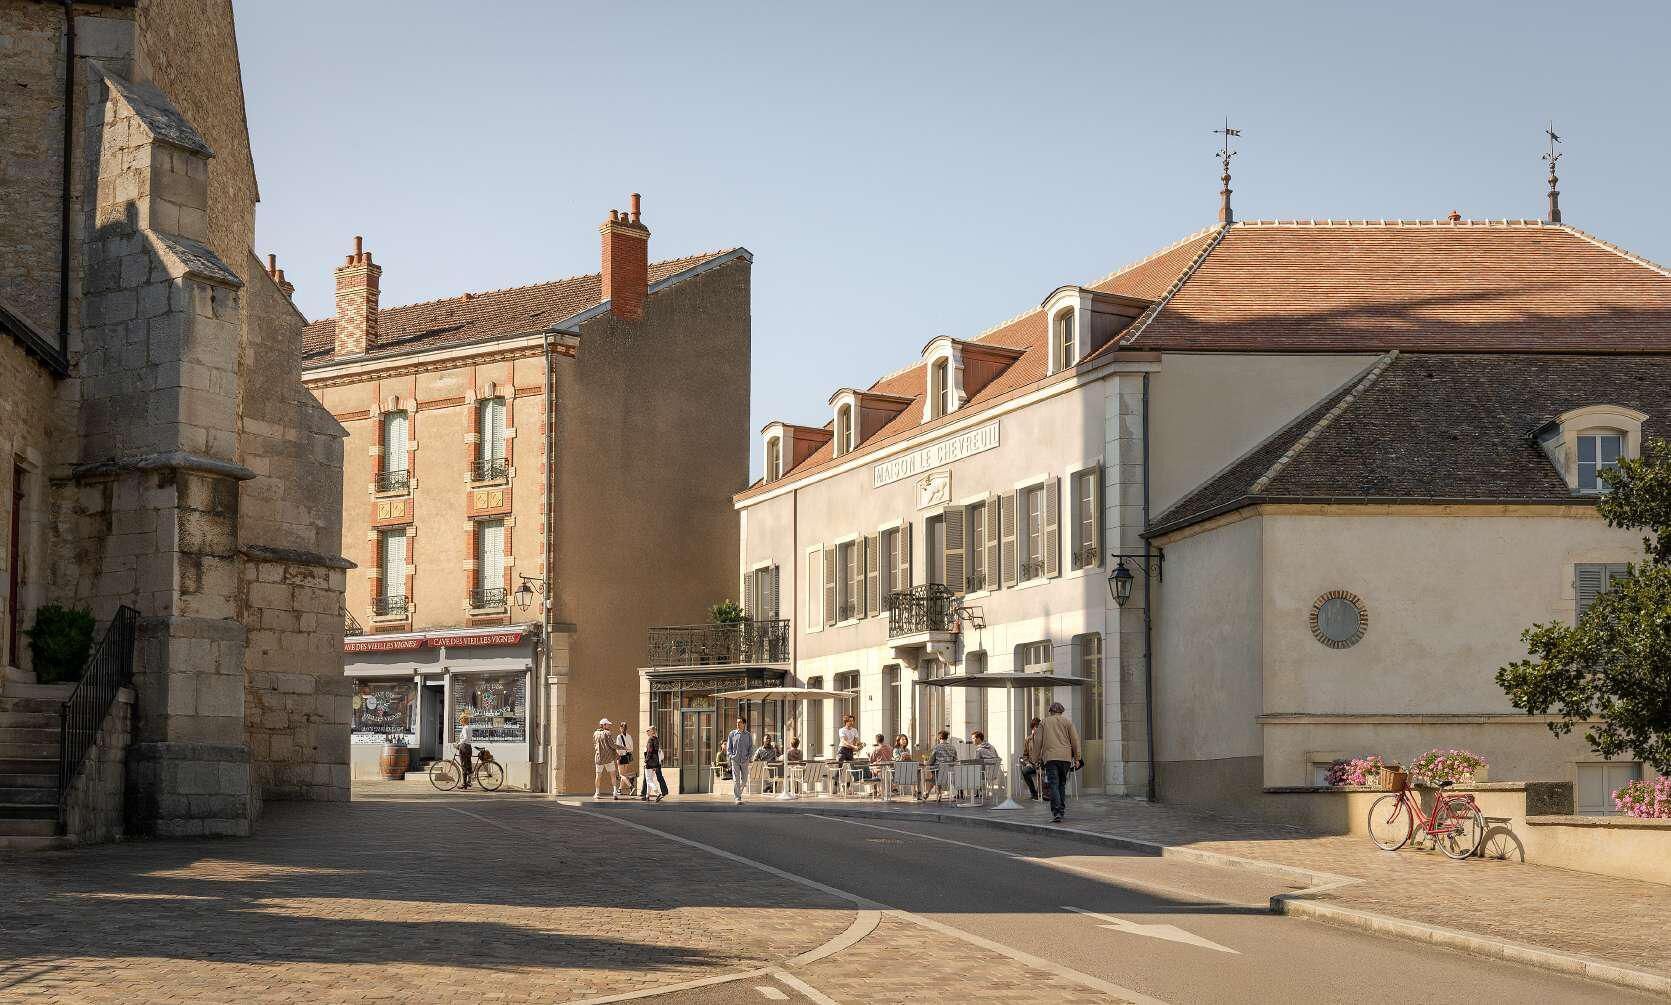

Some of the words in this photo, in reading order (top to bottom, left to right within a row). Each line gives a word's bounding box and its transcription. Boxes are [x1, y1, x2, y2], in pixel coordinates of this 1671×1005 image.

[876, 455, 915, 484] MAISON
[920, 449, 932, 468] LE
[937, 425, 999, 463] CHEVREUIL
[344, 643, 356, 651] AVE
[356, 642, 368, 651] DES
[394, 640, 417, 649] VIGNES
[433, 638, 450, 646] CAVE
[464, 636, 490, 645] VIEILLES
[491, 634, 515, 643] VIGNES
